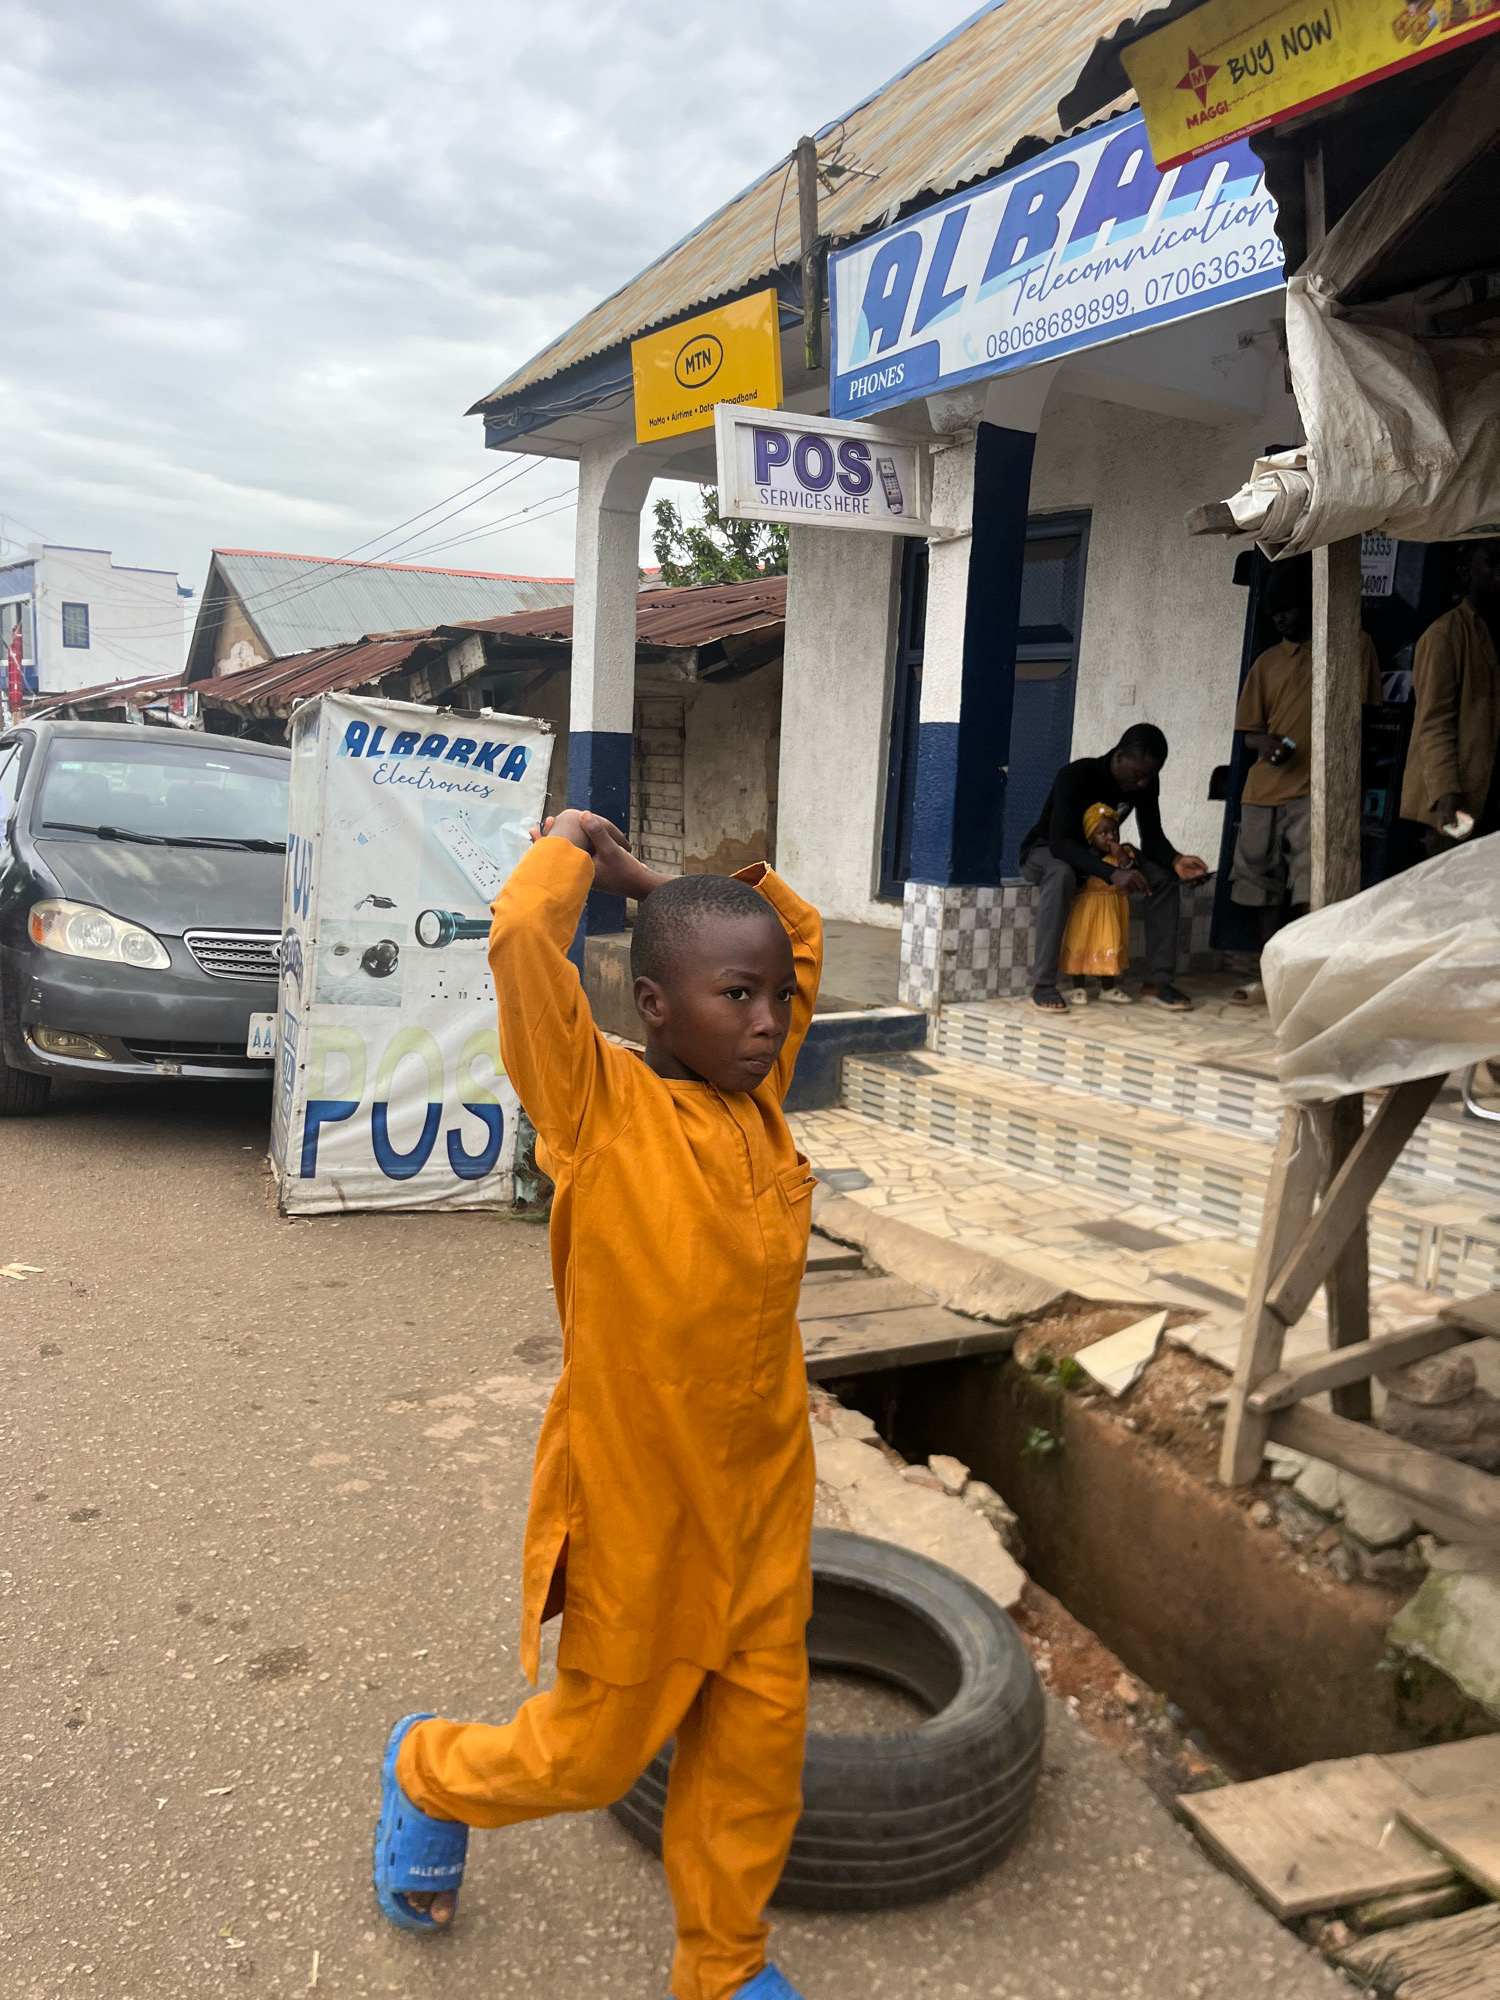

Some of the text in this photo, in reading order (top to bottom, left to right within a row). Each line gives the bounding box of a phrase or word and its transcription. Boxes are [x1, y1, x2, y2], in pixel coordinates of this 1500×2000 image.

[1227, 8, 1333, 84] BUY NOW
[1186, 100, 1230, 130] MAGGI
[685, 348, 711, 375] MTN
[849, 363, 905, 401] PHONES
[649, 416, 666, 427] MoMo
[671, 409, 693, 421] Airtime
[699, 403, 715, 413] Data
[752, 427, 874, 496] POS
[336, 720, 533, 782] ALBARKA
[373, 762, 495, 798] Electronics
[252, 1026, 277, 1048] AA
[300, 1025, 507, 1181] POS
